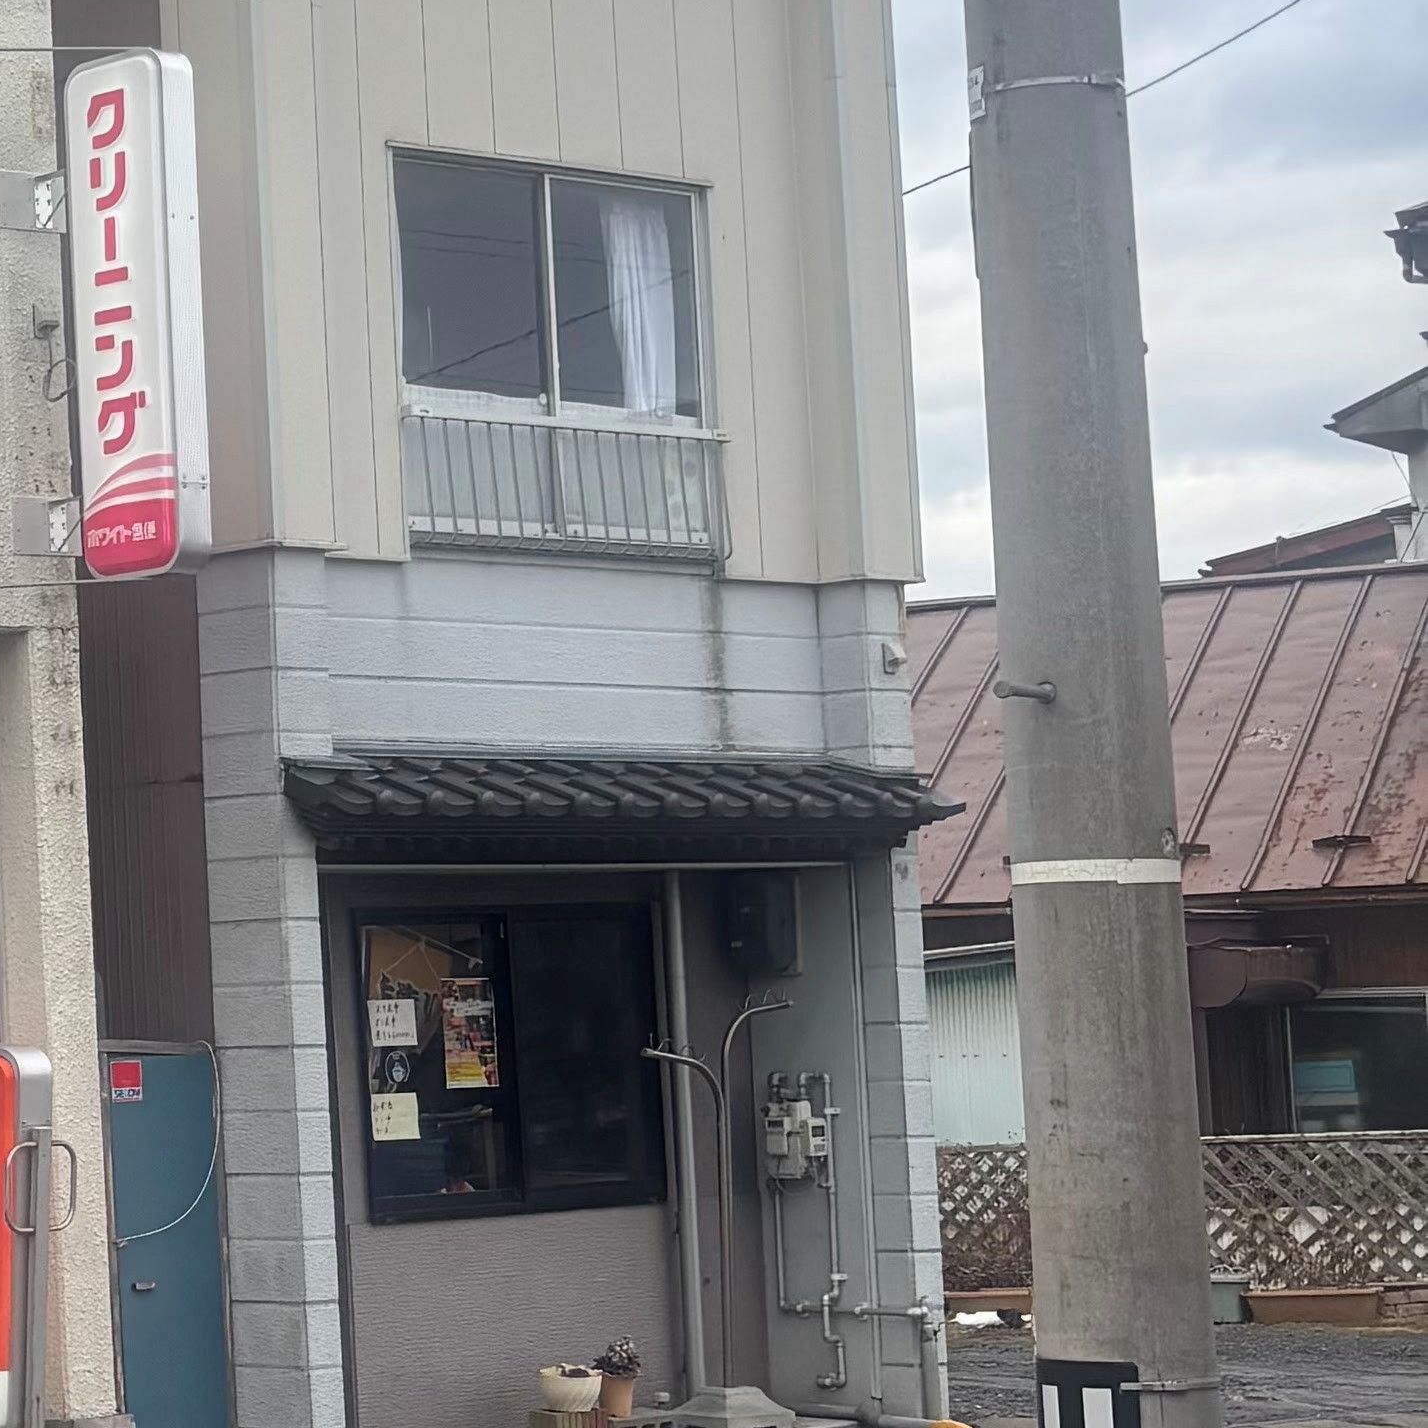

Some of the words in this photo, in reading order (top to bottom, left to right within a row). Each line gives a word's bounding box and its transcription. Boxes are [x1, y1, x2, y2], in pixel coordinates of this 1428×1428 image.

[86, 87, 147, 456] クリーニング
